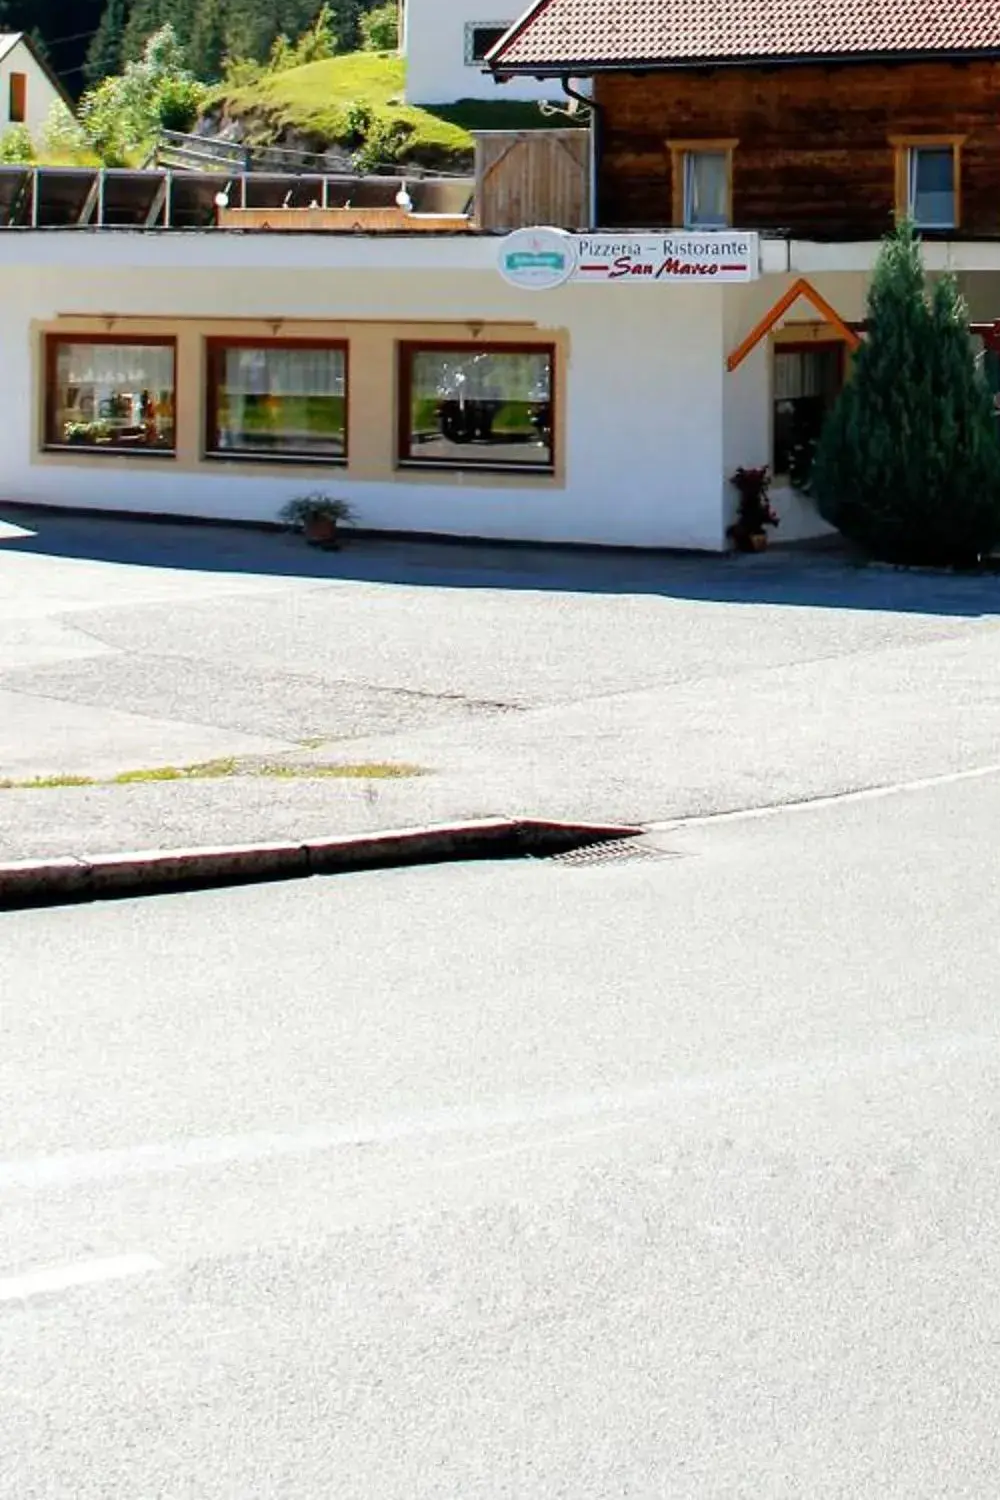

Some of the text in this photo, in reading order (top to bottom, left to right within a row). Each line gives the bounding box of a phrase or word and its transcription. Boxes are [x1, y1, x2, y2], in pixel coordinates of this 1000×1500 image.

[579, 240, 641, 257] Pizzeria
[663, 240, 748, 256] Ristorante
[608, 256, 718, 278] San Marco
